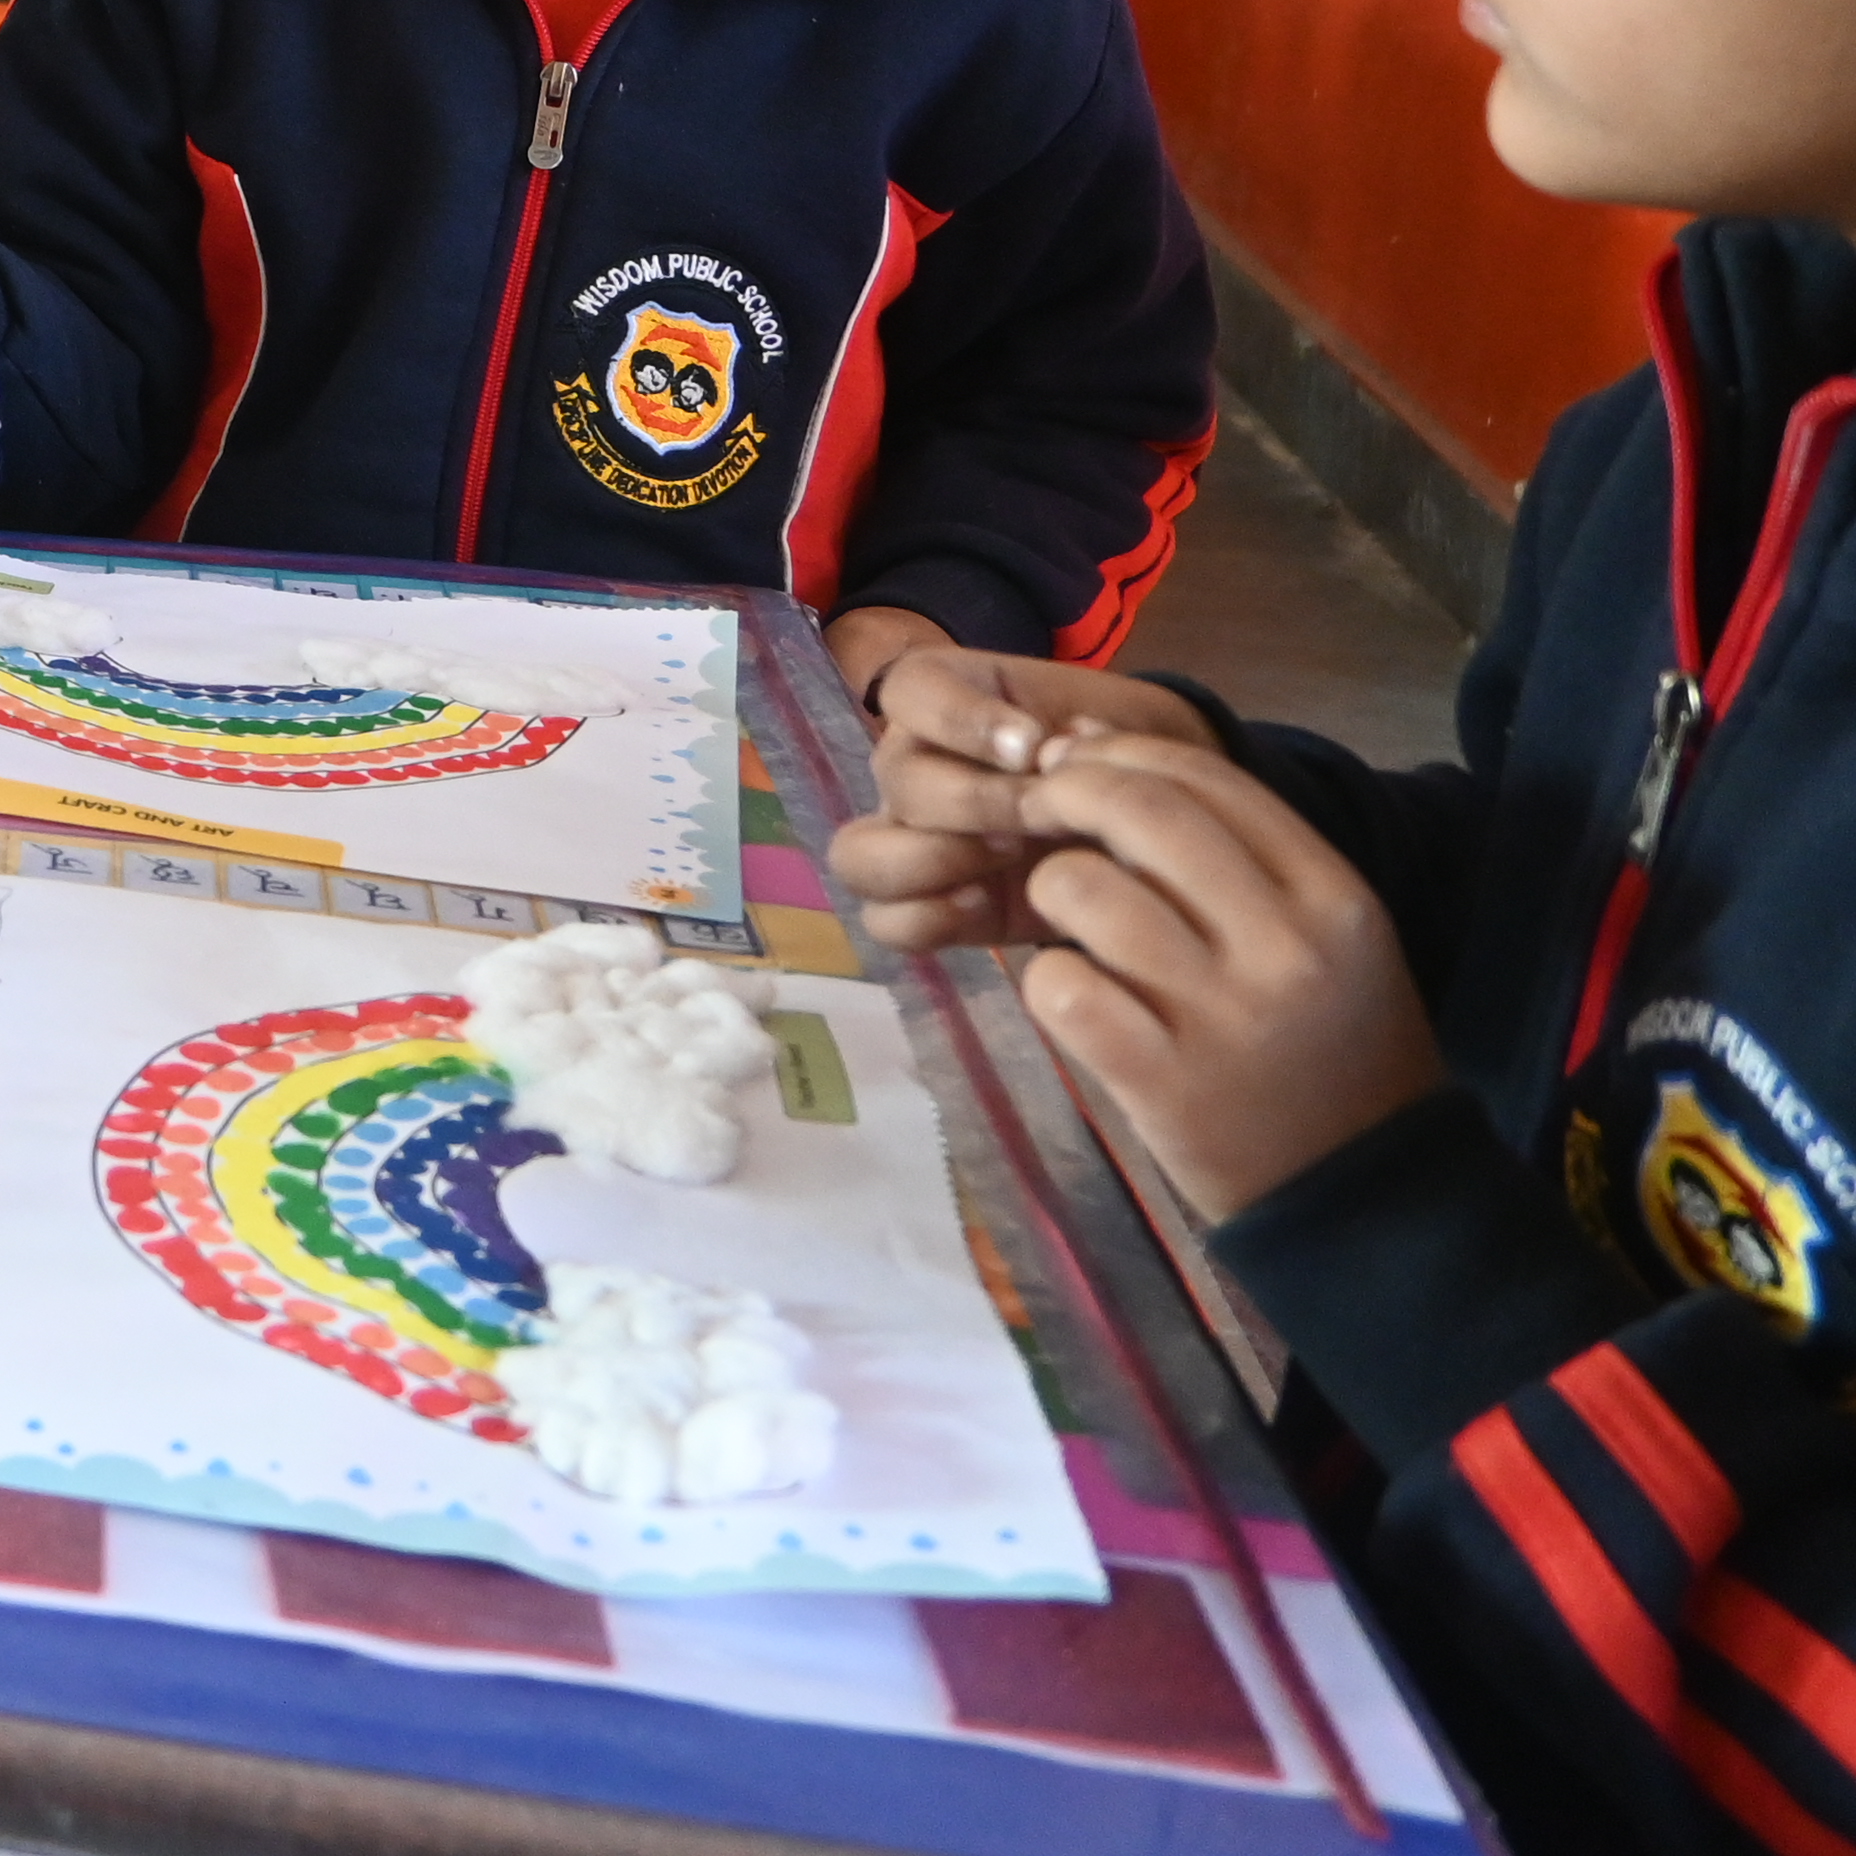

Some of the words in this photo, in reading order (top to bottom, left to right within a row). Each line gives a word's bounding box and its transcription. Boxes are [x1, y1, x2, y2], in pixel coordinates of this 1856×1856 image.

[572, 255, 664, 316] WISDOM
[667, 253, 743, 292] PUBLIC
[738, 285, 785, 363] SCHOOL
[606, 466, 691, 506] DEDICATION
[692, 444, 754, 502] DEVOTION
[57, 796, 128, 815] CRAFT
[133, 811, 186, 827] AND
[189, 825, 235, 837] ART
[30, 843, 93, 876] जू
[139, 854, 202, 887] छू
[450, 889, 514, 922] गू
